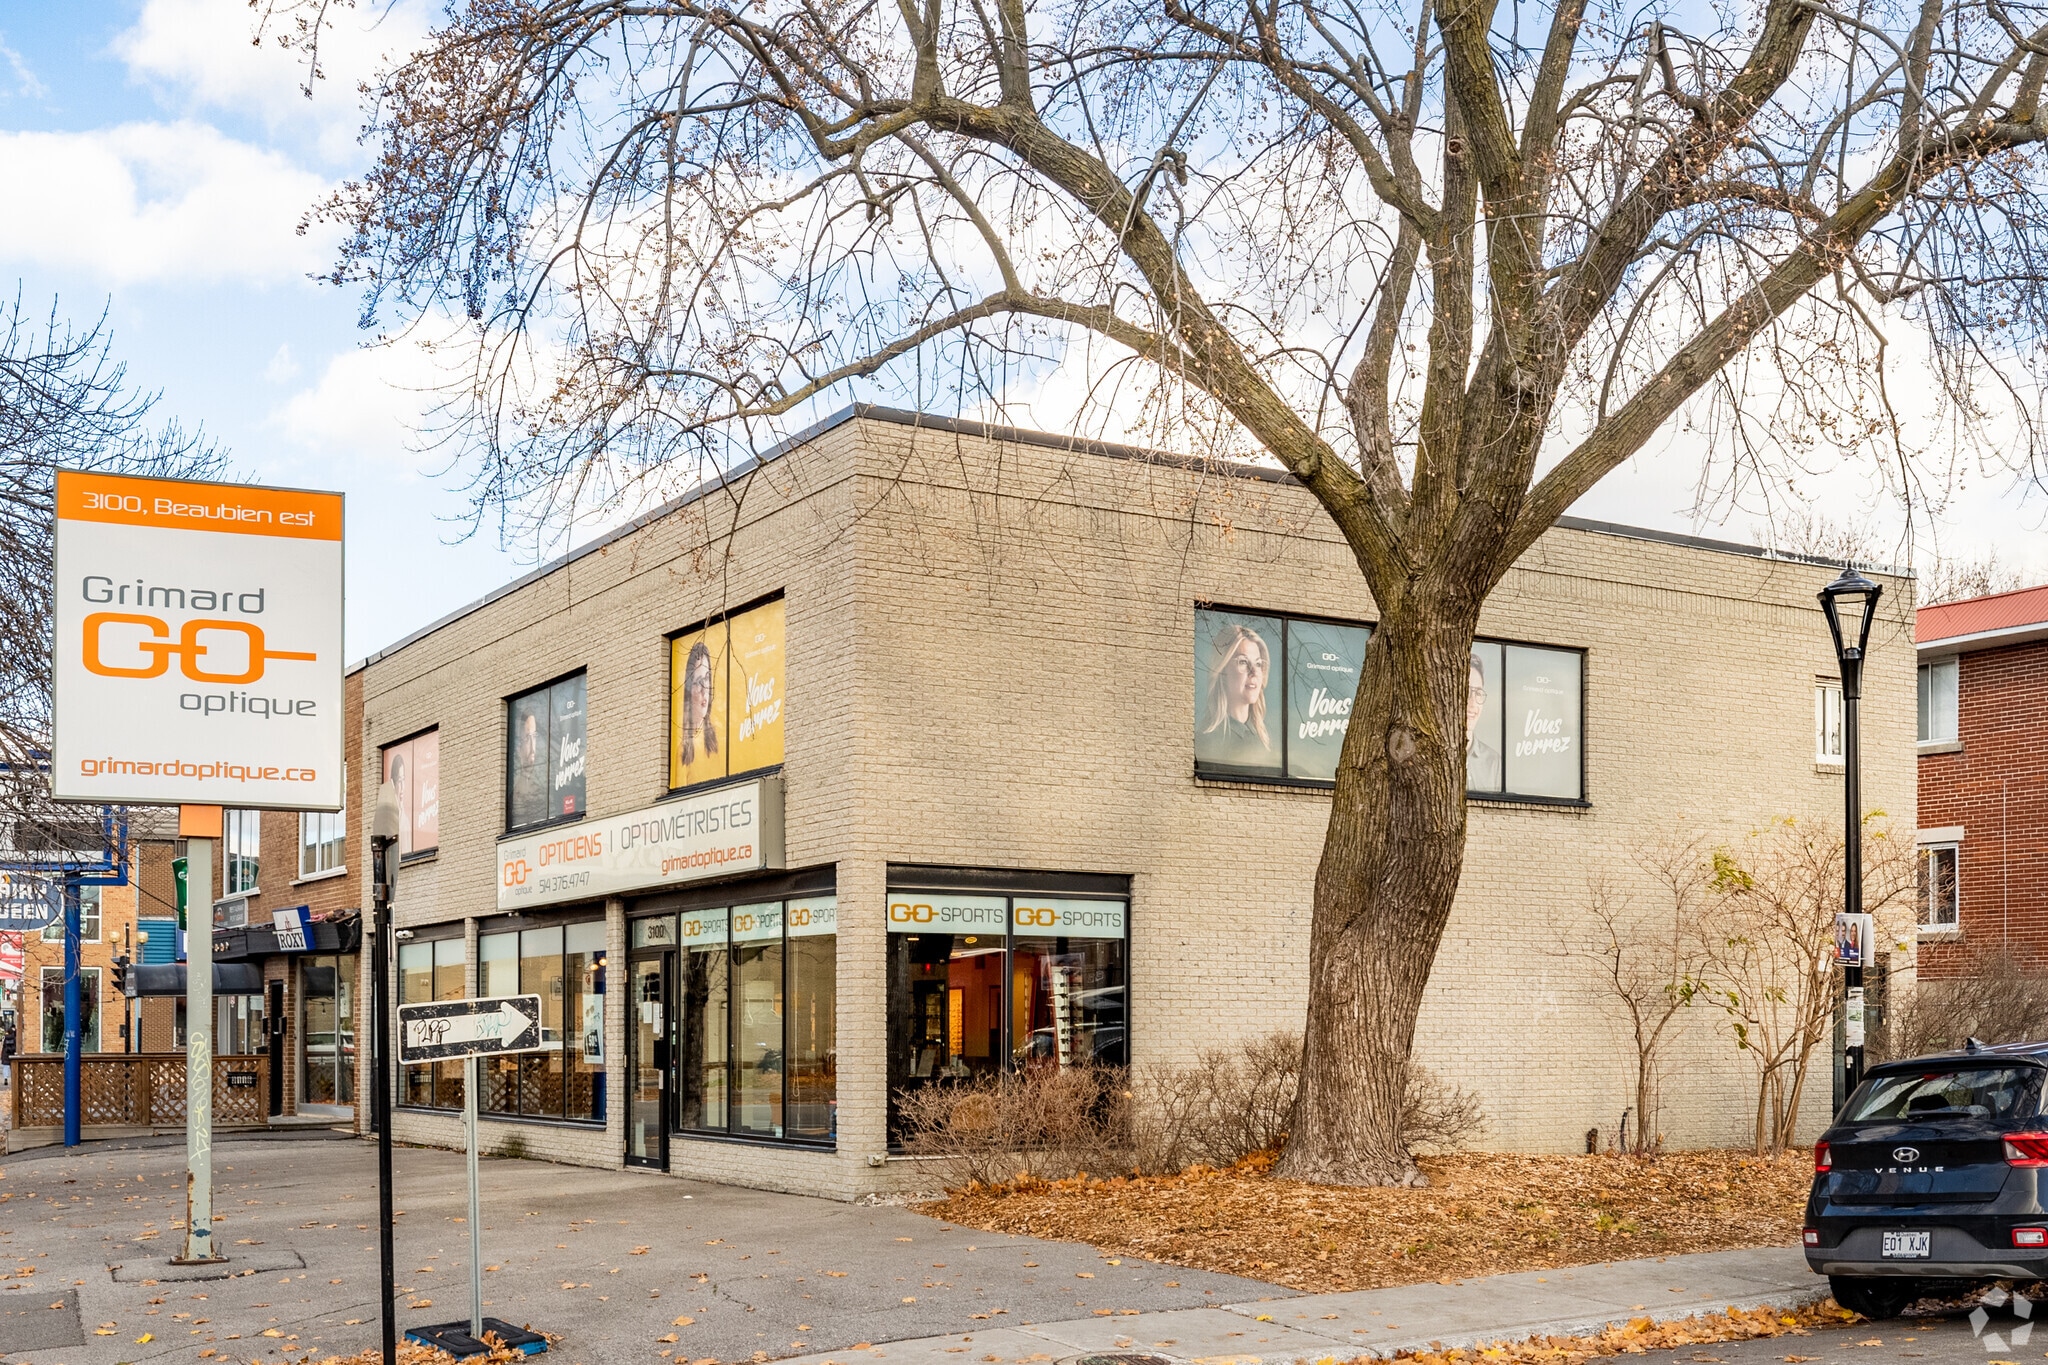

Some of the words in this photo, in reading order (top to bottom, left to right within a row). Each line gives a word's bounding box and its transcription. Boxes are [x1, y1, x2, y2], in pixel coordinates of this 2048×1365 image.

[82, 491, 147, 516] 3100,
[154, 498, 272, 524] Beaubien
[279, 510, 316, 527] est
[82, 575, 265, 614] Grimard
[1306, 662, 1331, 671] Grimard
[180, 690, 317, 720] optique
[745, 671, 775, 713] Vous
[1308, 687, 1352, 718] Vous
[1298, 718, 1350, 739] verre
[1524, 709, 1562, 737] Vous
[559, 733, 581, 768] Vous
[1515, 736, 1571, 758] verrez
[80, 755, 317, 783] grimardoptique.ca
[538, 832, 602, 867] OPTICIENS
[621, 800, 751, 850] OPTOMÉTRISTES
[503, 846, 527, 861] Grimard
[661, 844, 752, 876] grimardoptique.ca
[514, 885, 532, 896] optique
[279, 932, 305, 948] ROXY
[647, 924, 665, 939] 3100
[1874, 1166, 1944, 1174] VENUE
[1884, 1237, 1902, 1251] E01
[1909, 1237, 1928, 1251] XJK
